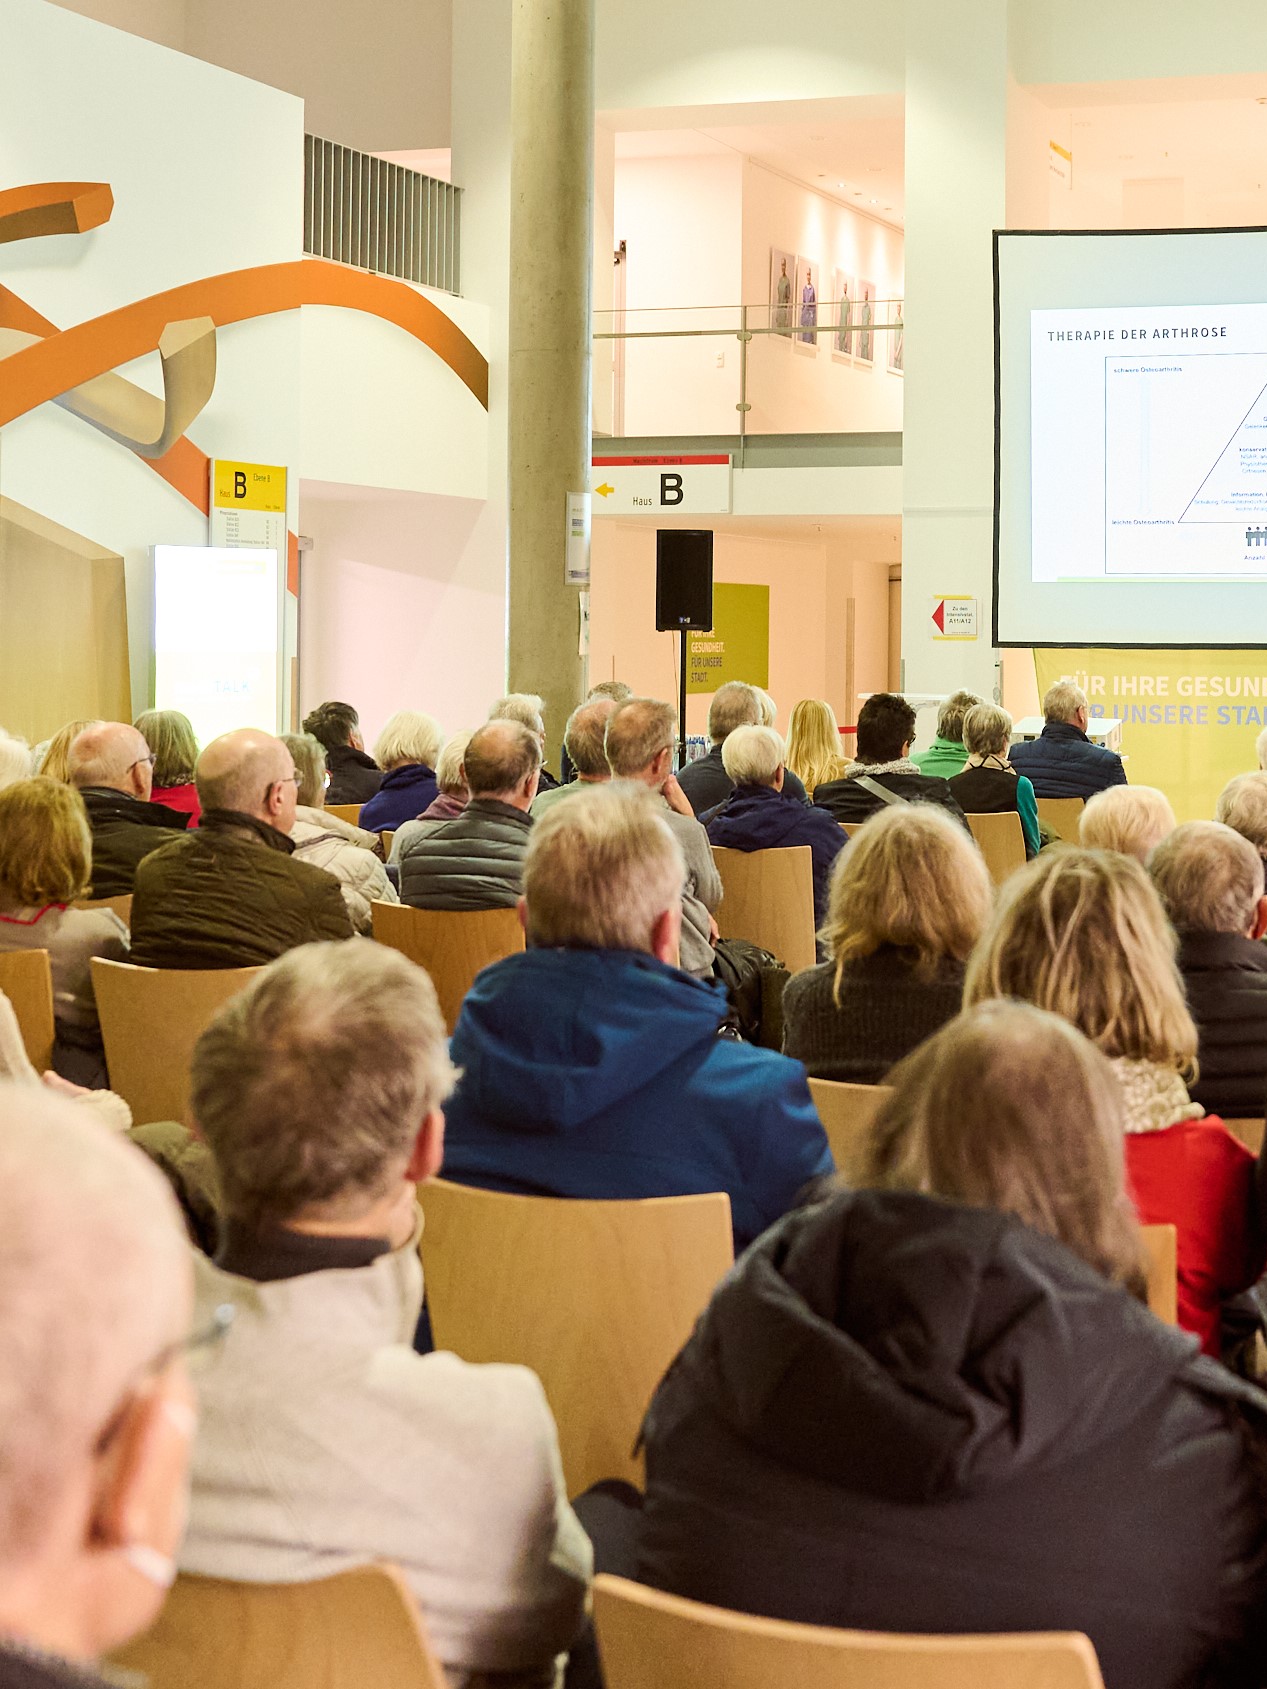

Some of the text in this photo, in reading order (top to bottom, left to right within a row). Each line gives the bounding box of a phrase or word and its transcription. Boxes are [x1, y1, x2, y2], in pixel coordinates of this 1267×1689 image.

[1048, 326, 1227, 341] THERAPIE DER ARTHROSE
[234, 471, 247, 499] B
[632, 473, 684, 506] Haus B
[691, 641, 725, 653] GESUNDHEIT.
[691, 654, 722, 668] FÜR UNSERE
[1113, 675, 1169, 697] IHRE
[1113, 704, 1209, 725] UNSERE
